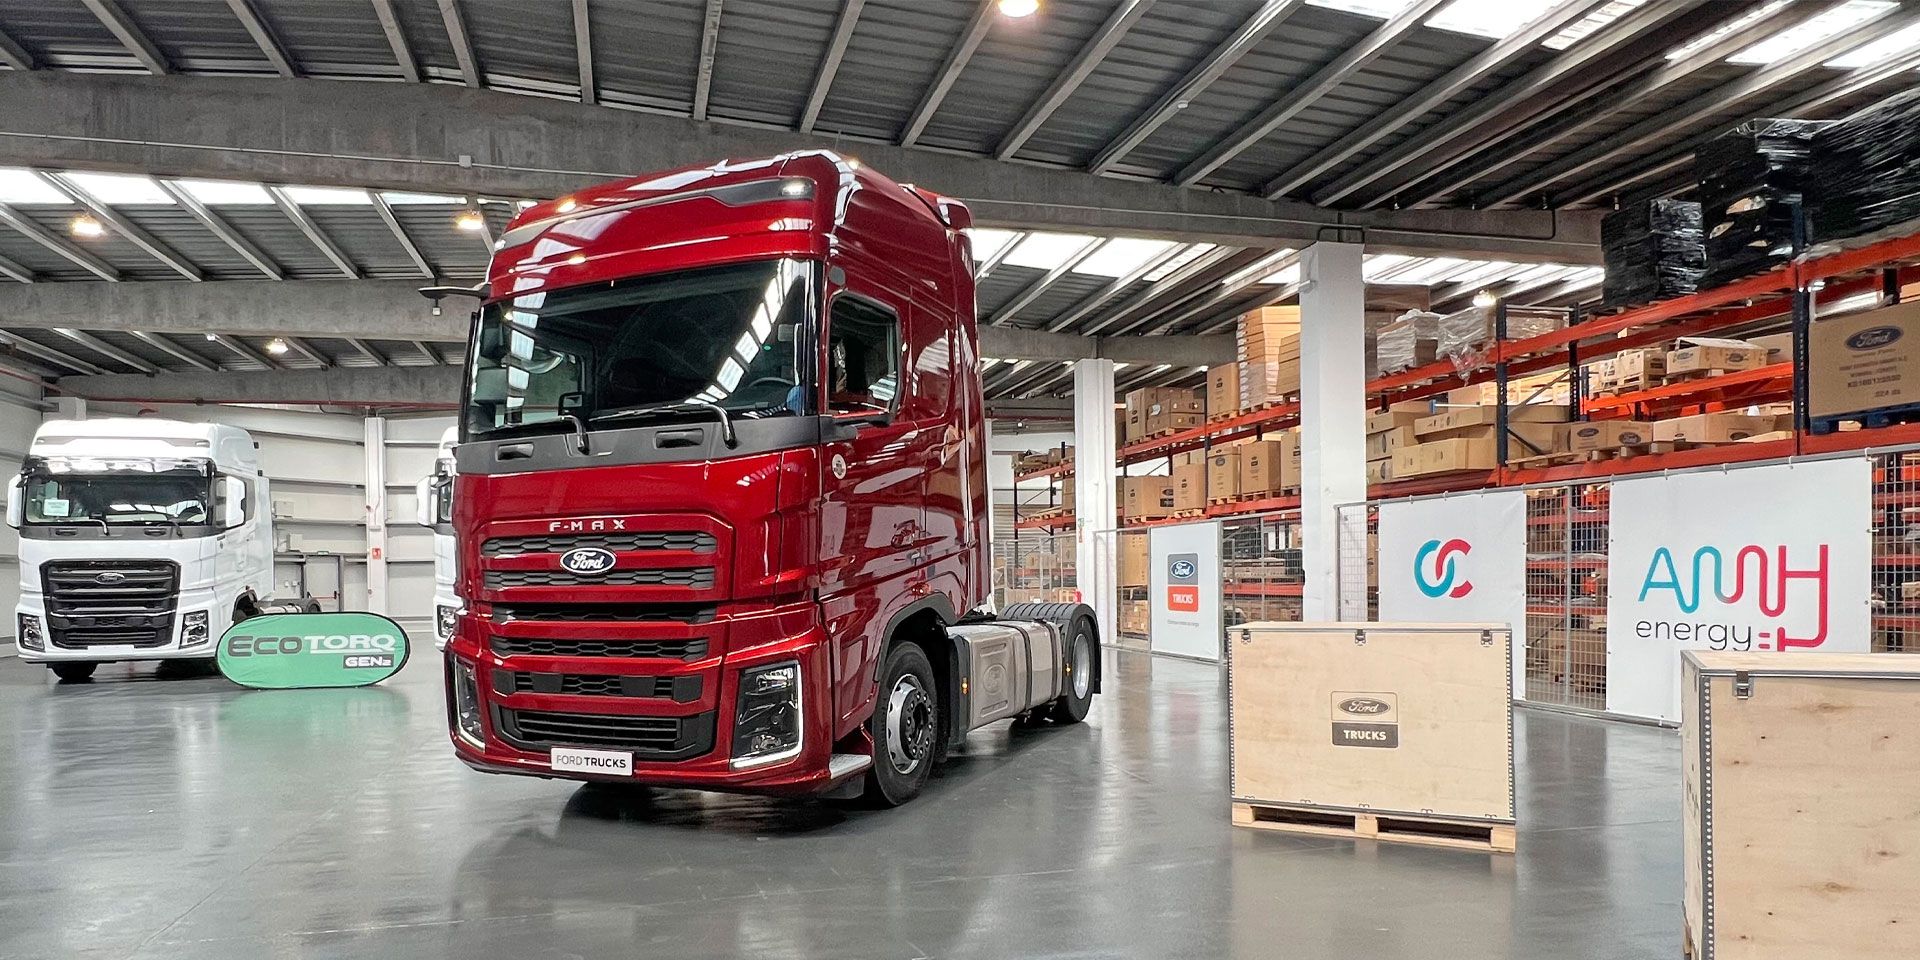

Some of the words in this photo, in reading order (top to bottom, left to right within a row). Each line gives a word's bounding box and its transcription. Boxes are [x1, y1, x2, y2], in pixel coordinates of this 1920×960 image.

[1856, 329, 1891, 348] Ford
[549, 519, 626, 532] F-MAX
[570, 551, 606, 569] Ford
[1638, 544, 1829, 617] AMH
[1636, 620, 1752, 651] energy
[345, 656, 392, 667] GEN2
[1348, 700, 1380, 713] Ford
[1343, 729, 1387, 741] TRUCKS
[584, 756, 627, 768] TRUCKS
